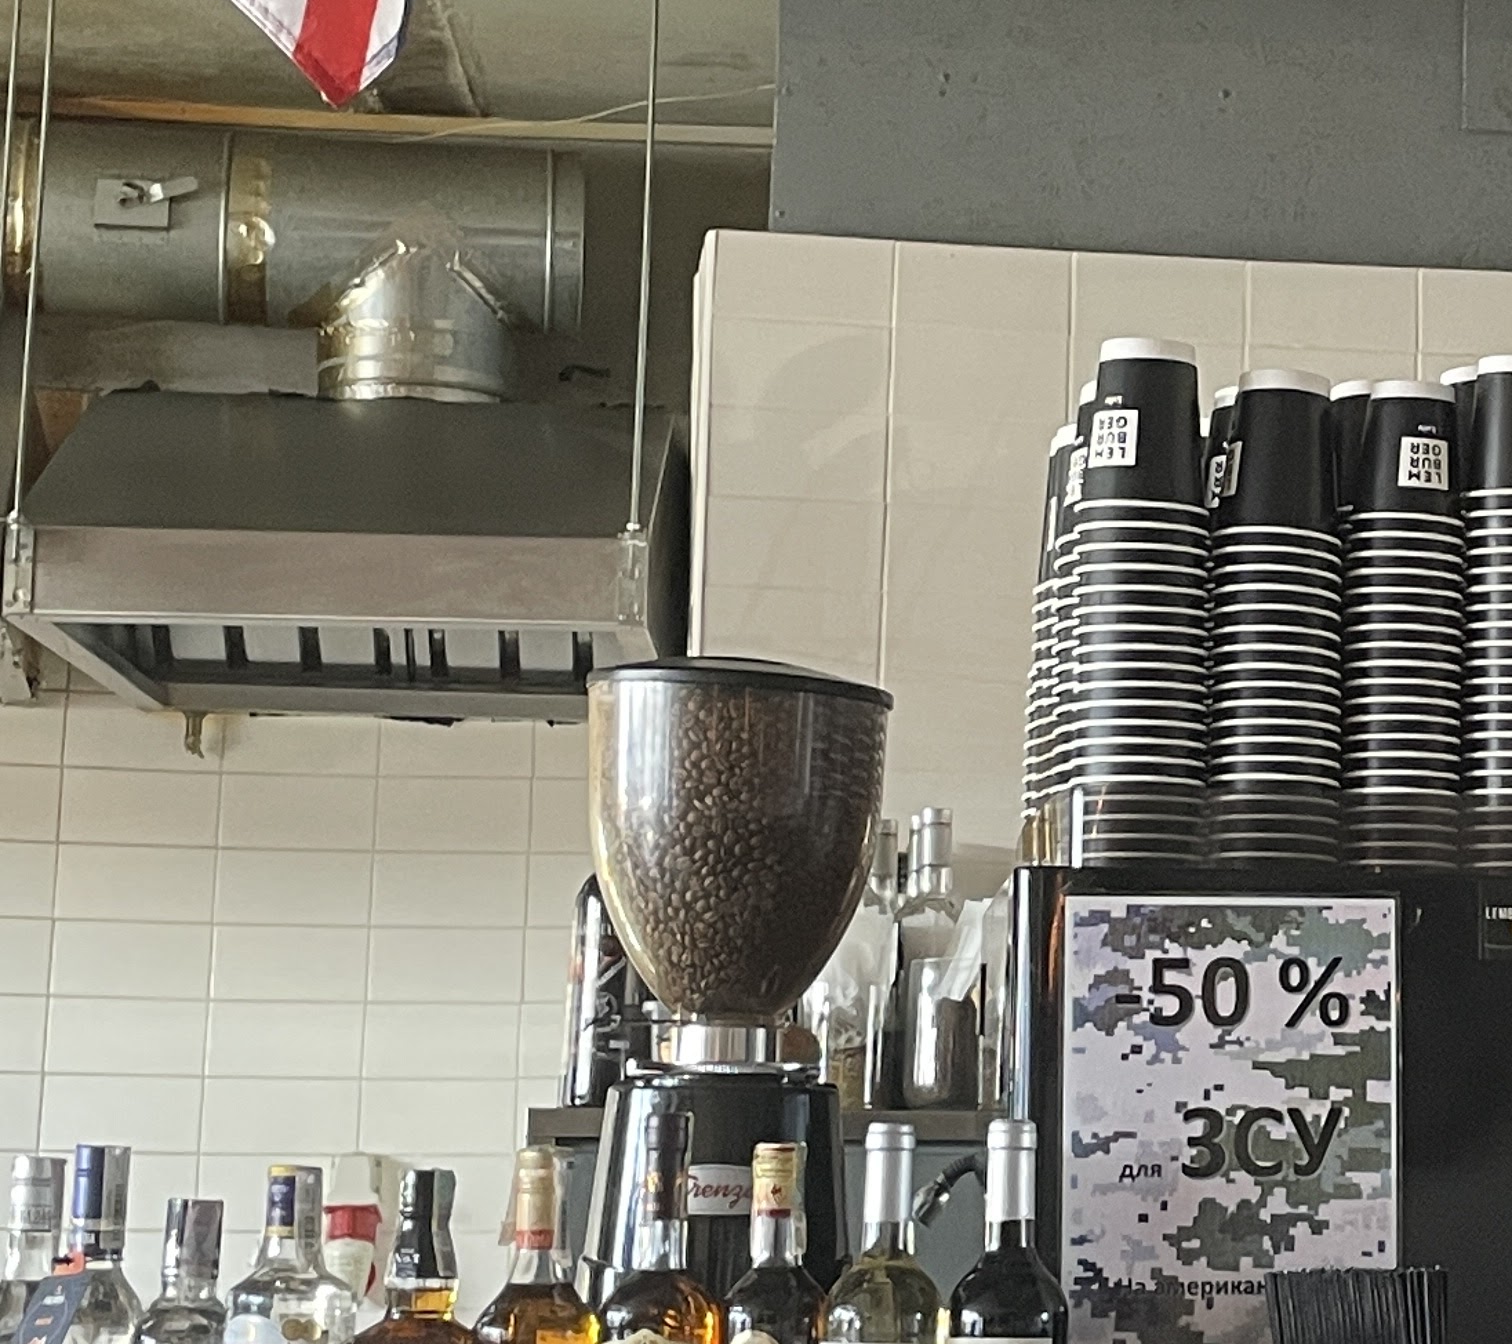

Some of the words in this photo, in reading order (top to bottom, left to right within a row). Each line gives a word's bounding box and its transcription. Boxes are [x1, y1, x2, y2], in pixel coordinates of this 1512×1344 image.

[1115, 956, 1249, 1028] -50
[1279, 956, 1350, 1029] %
[1118, 1161, 1163, 1184] для
[1180, 1106, 1346, 1180] ЗСУ
